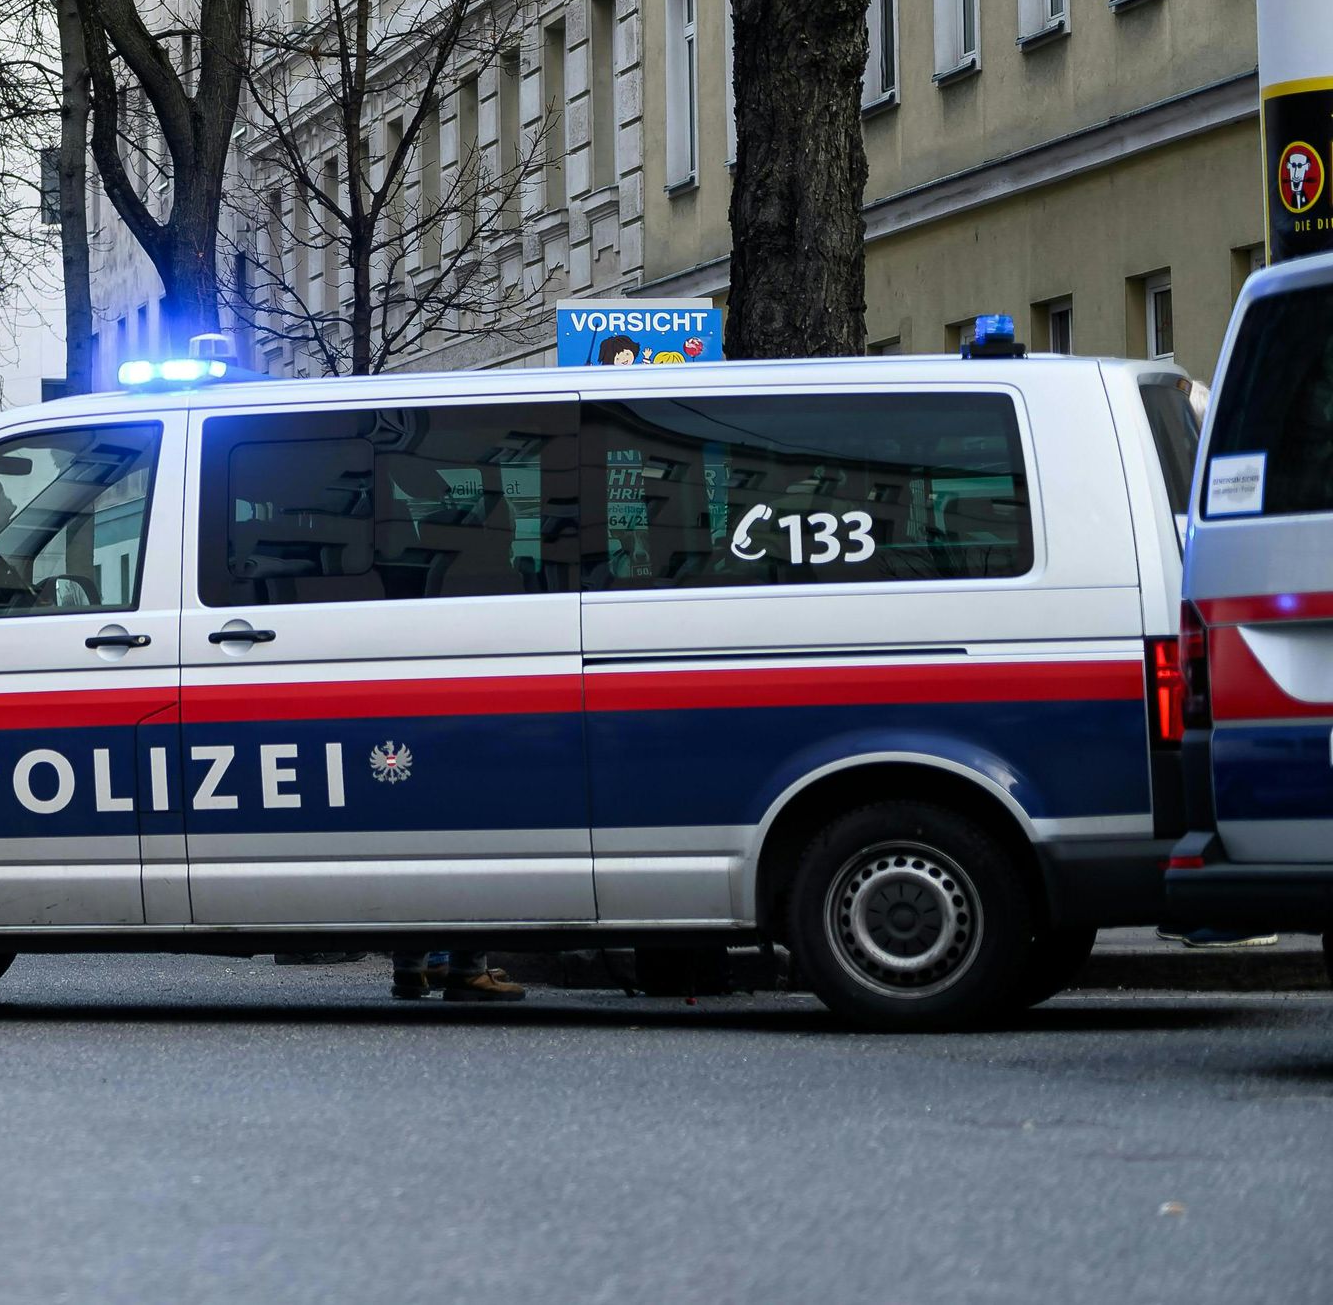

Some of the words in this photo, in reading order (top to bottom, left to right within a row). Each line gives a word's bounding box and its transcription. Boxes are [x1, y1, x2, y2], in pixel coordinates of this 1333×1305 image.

[1295, 220, 1311, 232] DIE
[570, 312, 708, 332] VORSICHT
[778, 511, 876, 564] 133
